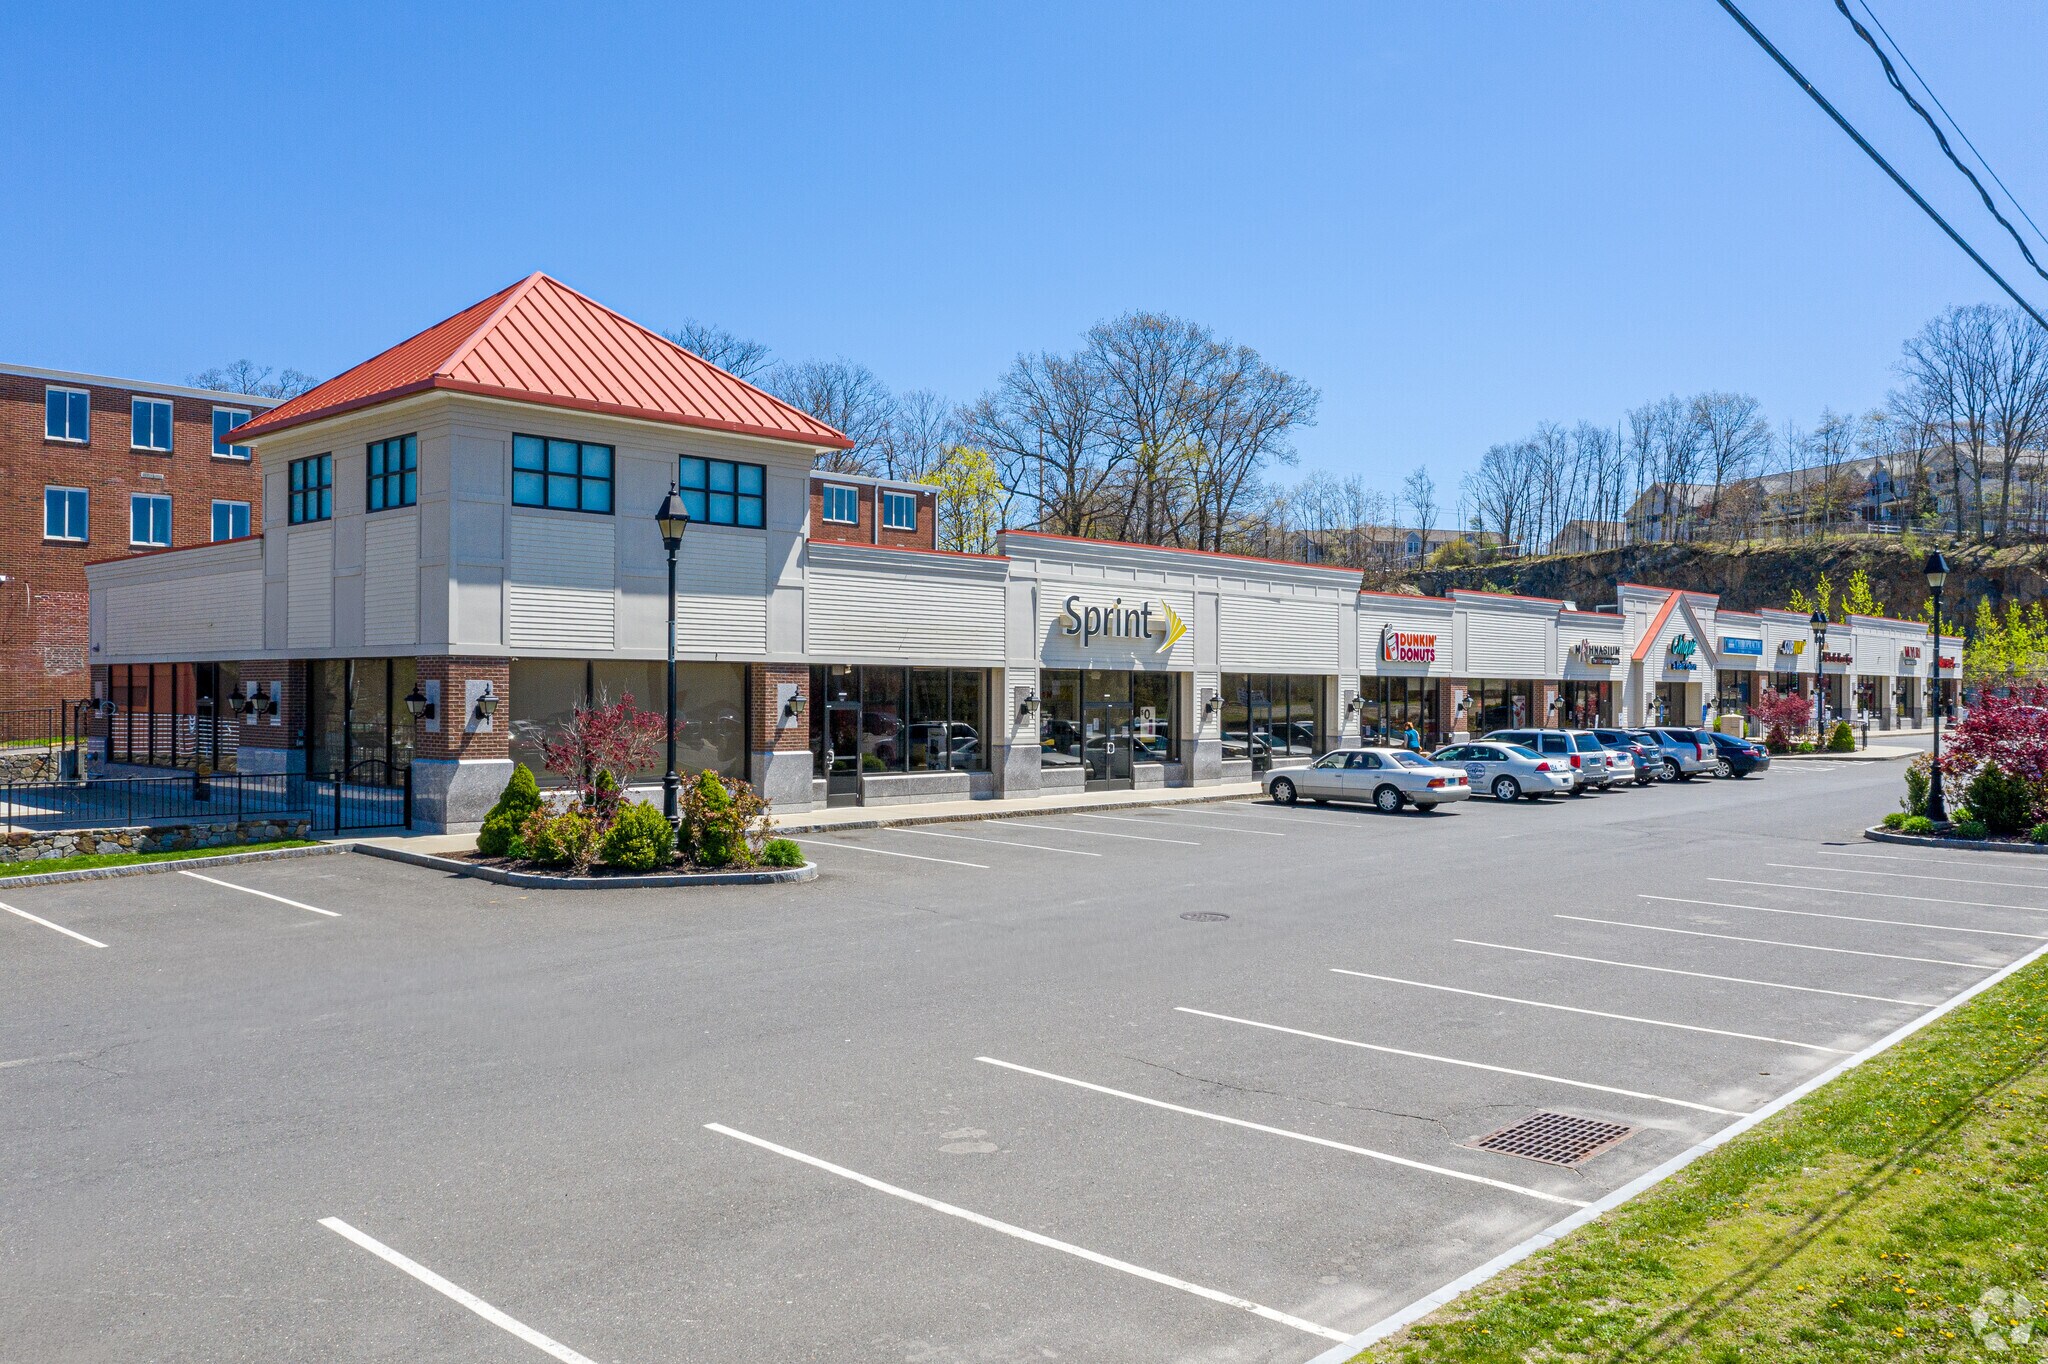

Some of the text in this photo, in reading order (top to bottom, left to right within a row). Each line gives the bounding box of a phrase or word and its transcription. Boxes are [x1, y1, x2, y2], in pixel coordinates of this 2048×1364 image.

[1064, 595, 1152, 647] Sprint
[1399, 632, 1437, 647] DUNKIN'
[1399, 647, 1435, 662] DONUTS
